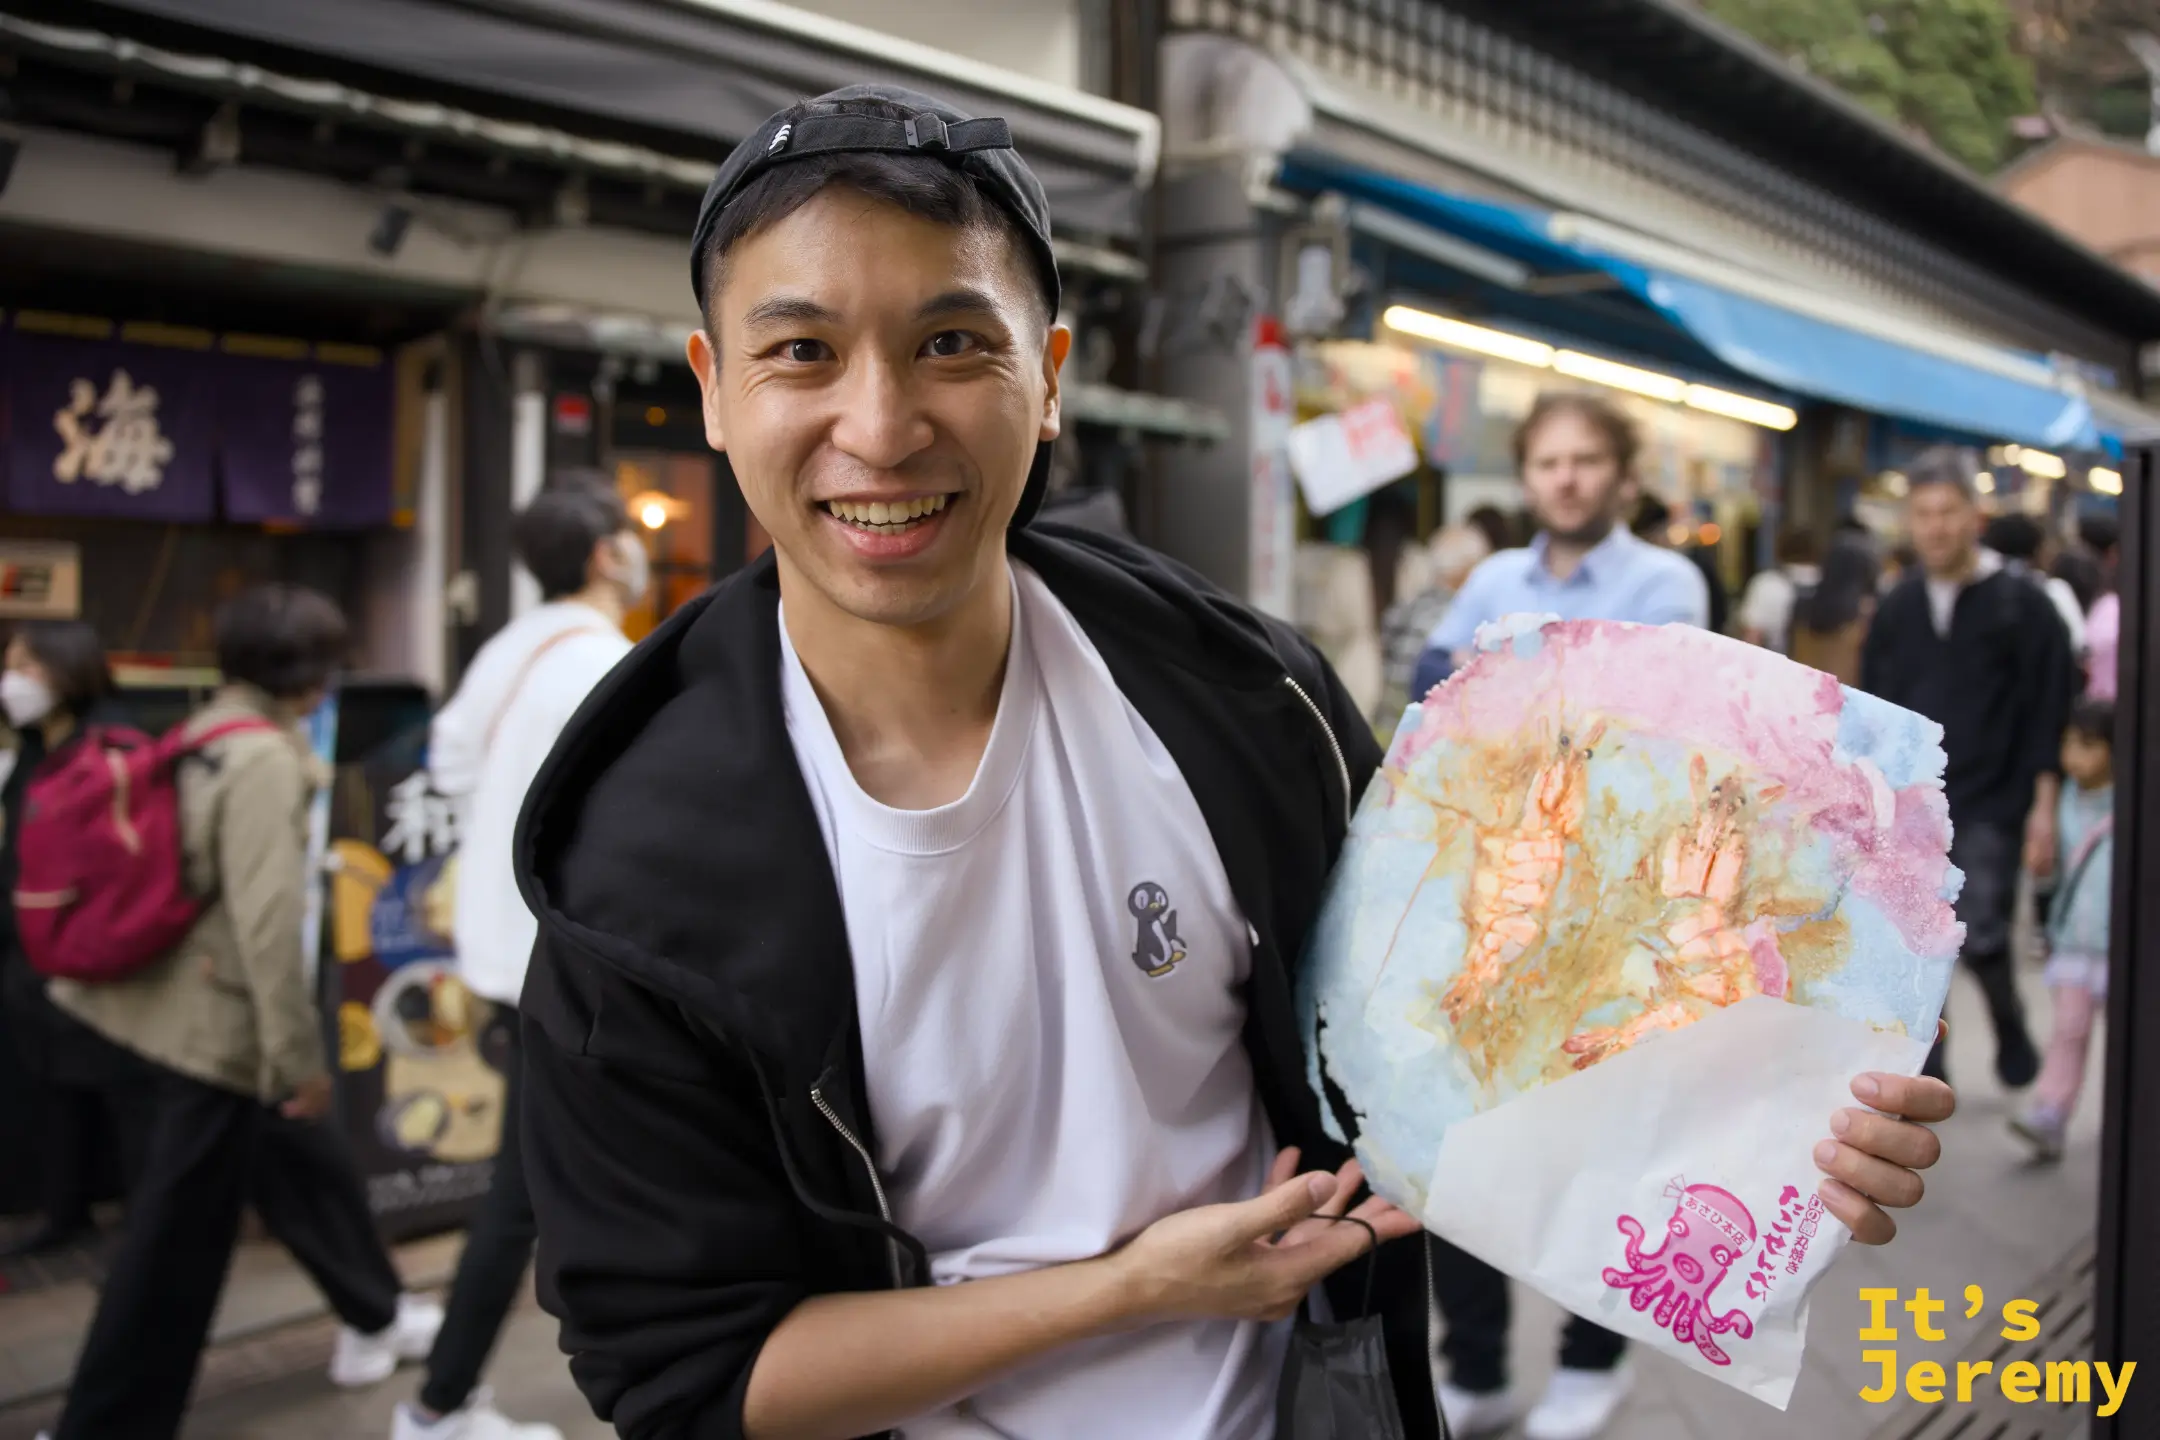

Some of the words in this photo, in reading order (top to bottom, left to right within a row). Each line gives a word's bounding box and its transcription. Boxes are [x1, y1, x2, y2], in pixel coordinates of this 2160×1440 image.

[53, 367, 175, 496] 海
[1685, 1196, 1748, 1246] あさひ本店
[1745, 1184, 1804, 1302] たこせんべい
